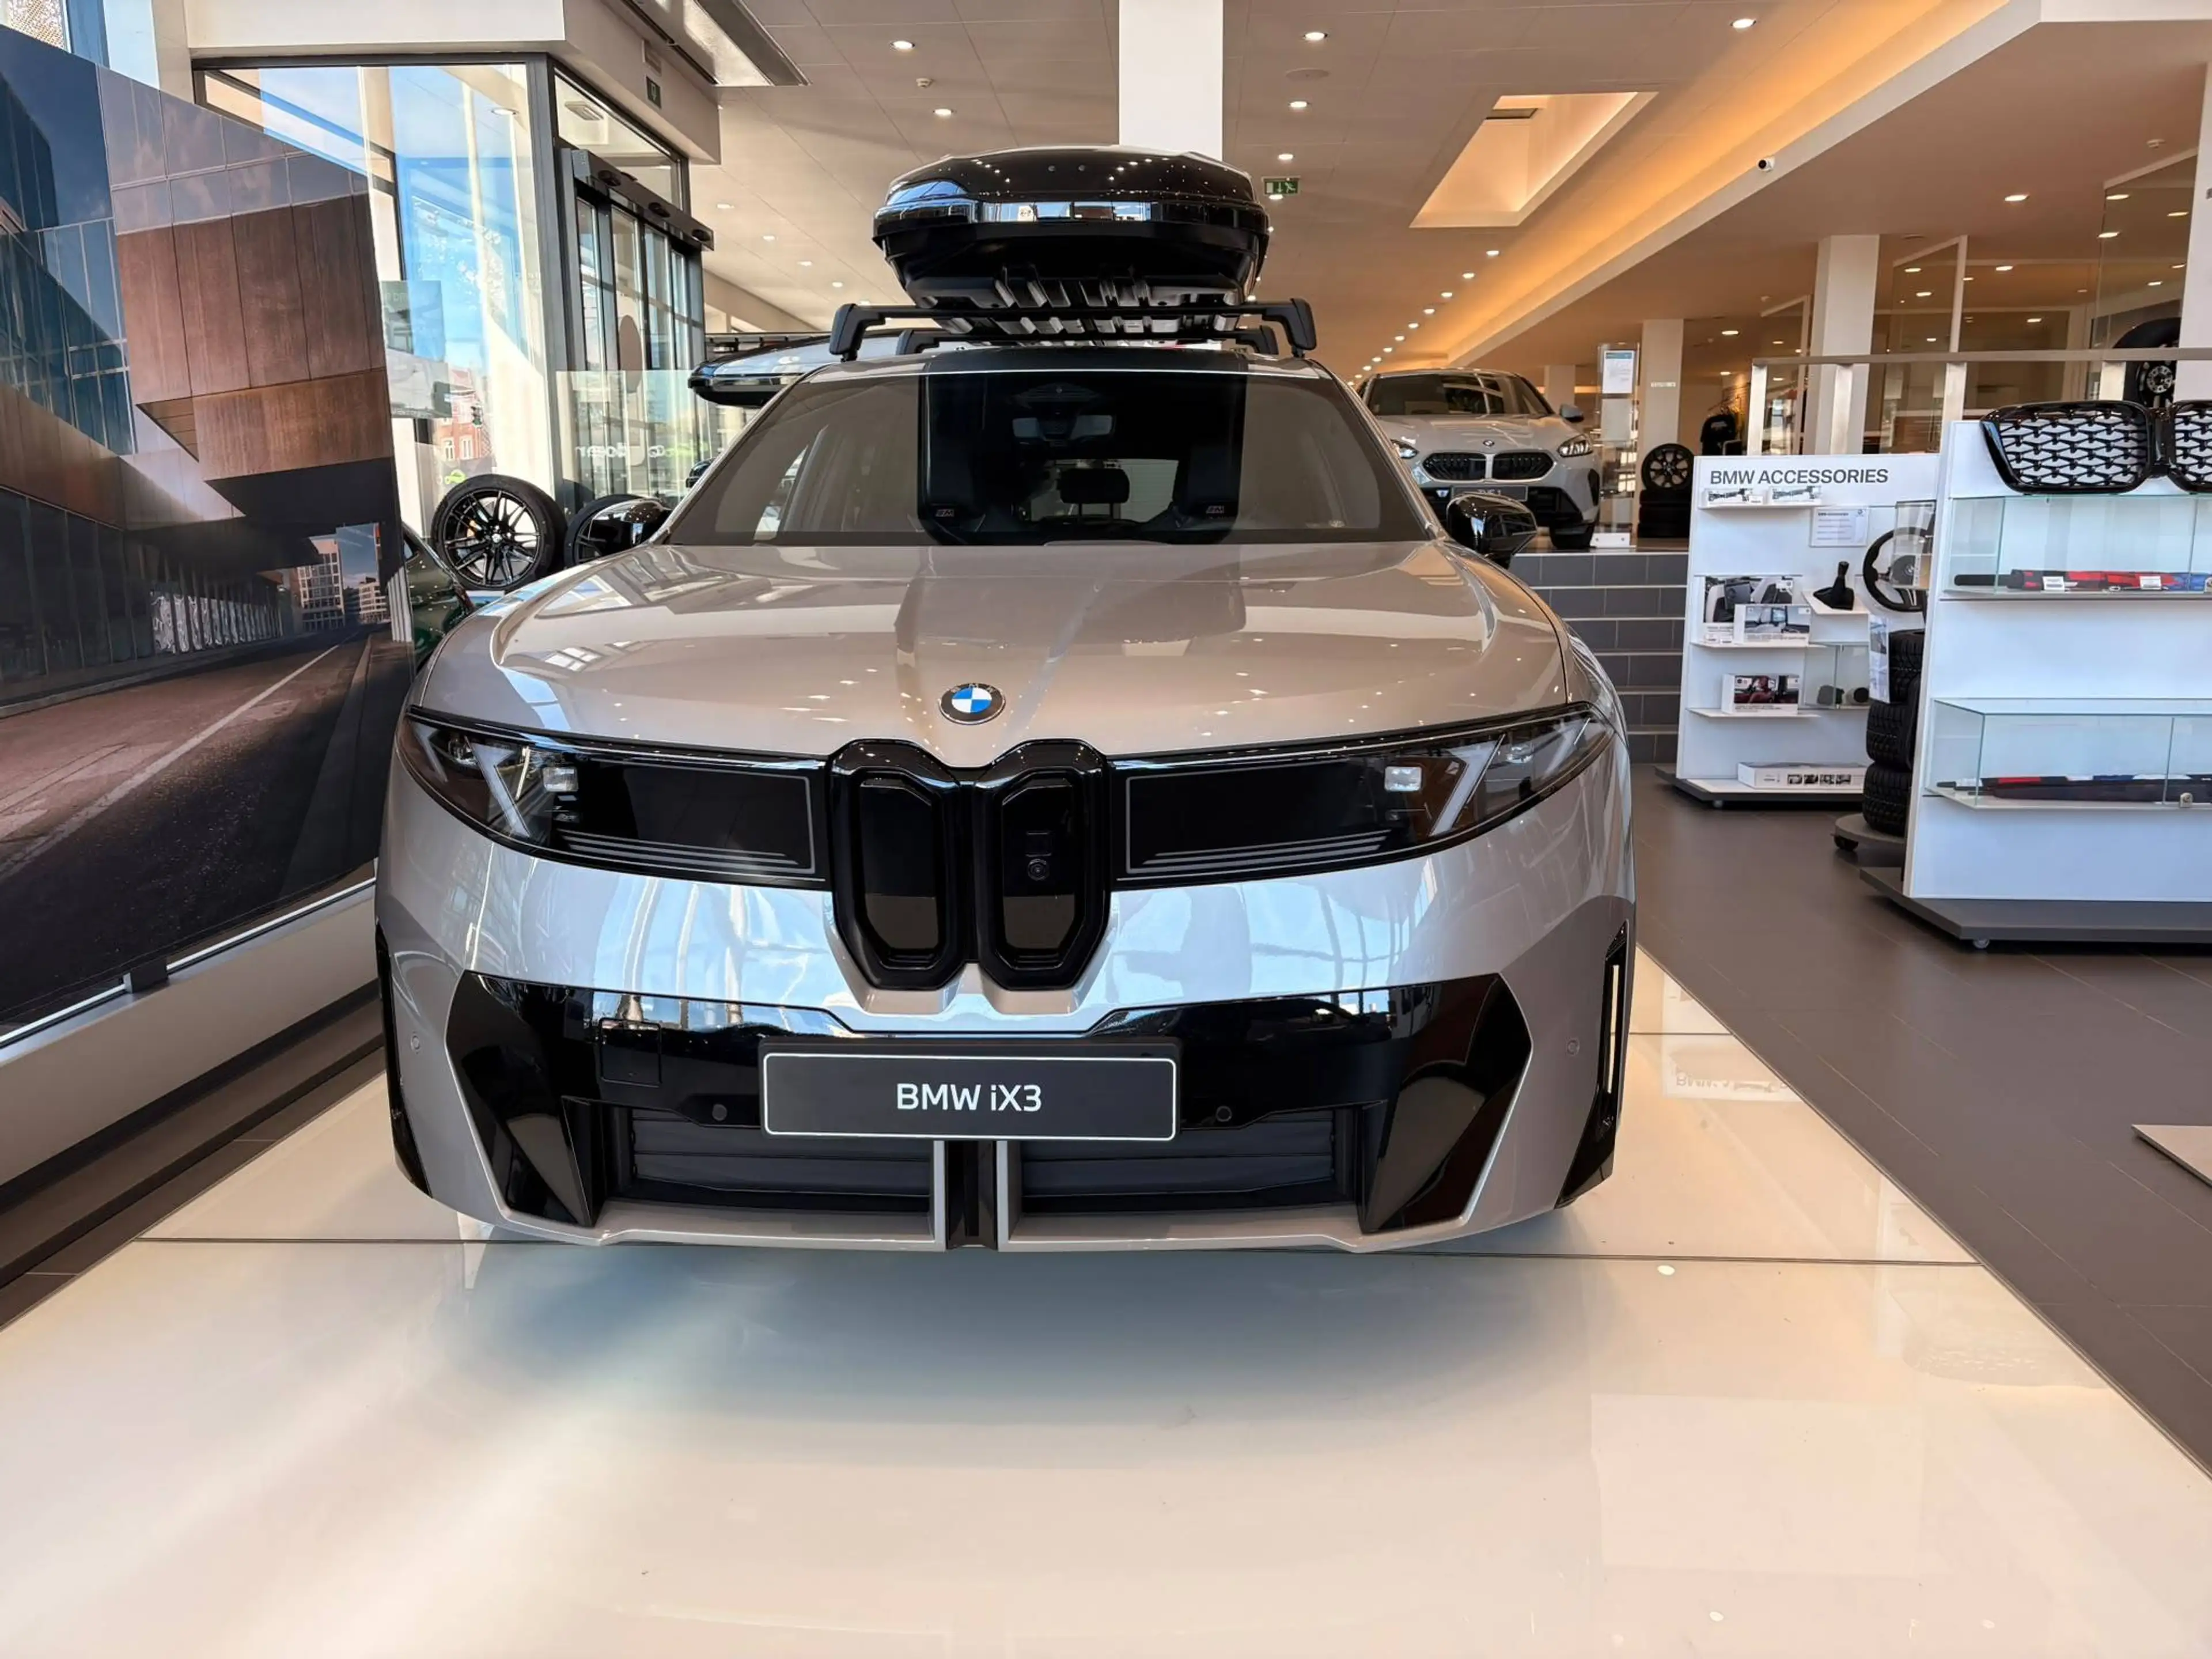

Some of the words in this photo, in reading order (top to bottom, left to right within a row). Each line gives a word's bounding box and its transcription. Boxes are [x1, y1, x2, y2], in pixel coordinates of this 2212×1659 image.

[1710, 470, 1755, 484] BMW
[1758, 469, 1889, 484] ACCESSORIES
[896, 1083, 982, 1111] BMW
[990, 1084, 1042, 1112] iX3
